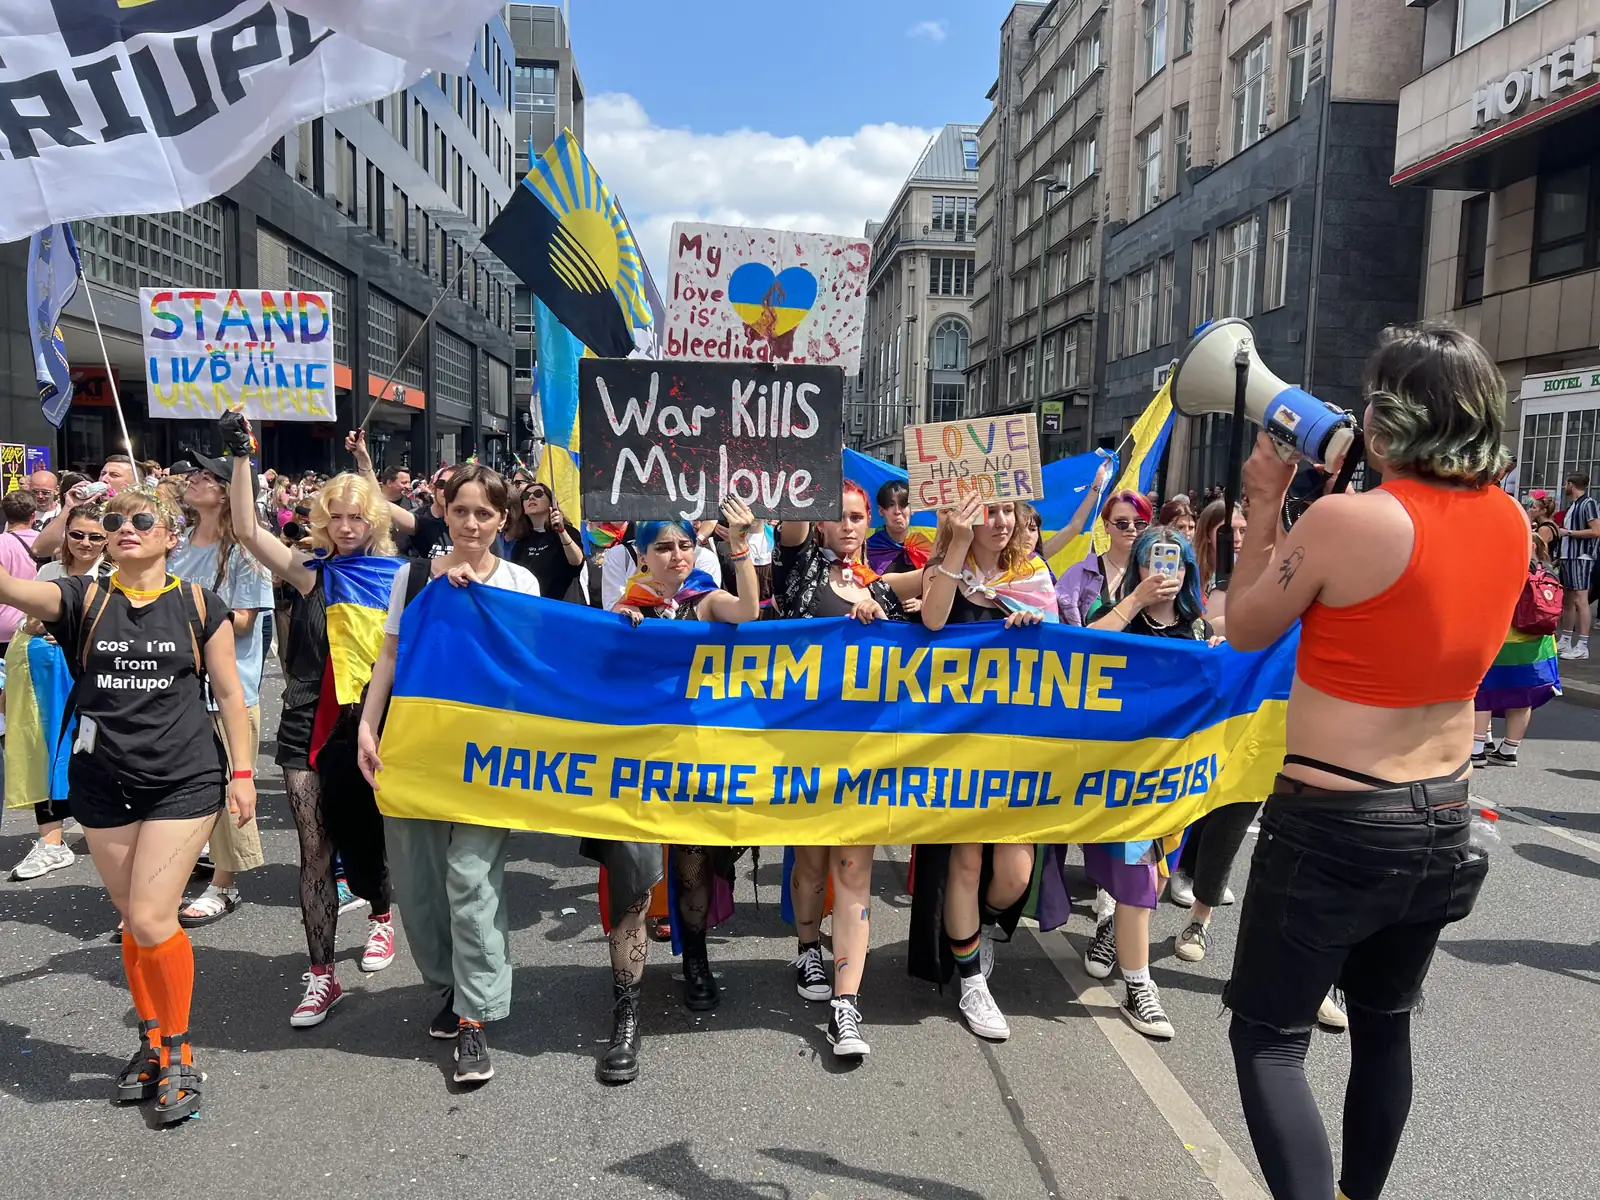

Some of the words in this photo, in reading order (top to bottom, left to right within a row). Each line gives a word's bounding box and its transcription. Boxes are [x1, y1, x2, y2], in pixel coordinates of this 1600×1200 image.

[1471, 32, 1598, 129] HOTEL
[679, 233, 721, 277] My
[674, 272, 724, 302] love
[150, 289, 330, 344] STAND
[690, 305, 711, 327] is
[205, 341, 275, 363] WITH
[595, 371, 716, 437] War
[1544, 377, 1582, 392] HOTEL
[915, 418, 1029, 463] LOVE
[611, 444, 706, 521] My
[718, 444, 815, 510] love
[918, 469, 1033, 507] GENDER
[930, 459, 970, 480] HAS
[983, 453, 1013, 472] NO
[114, 656, 158, 670] from
[686, 644, 823, 700] ARM
[841, 645, 1128, 712] UKRAINE
[464, 741, 597, 796] MAKE
[610, 757, 758, 805] PRIDE
[769, 765, 821, 805] IN
[833, 766, 1060, 809] MARIUPOL
